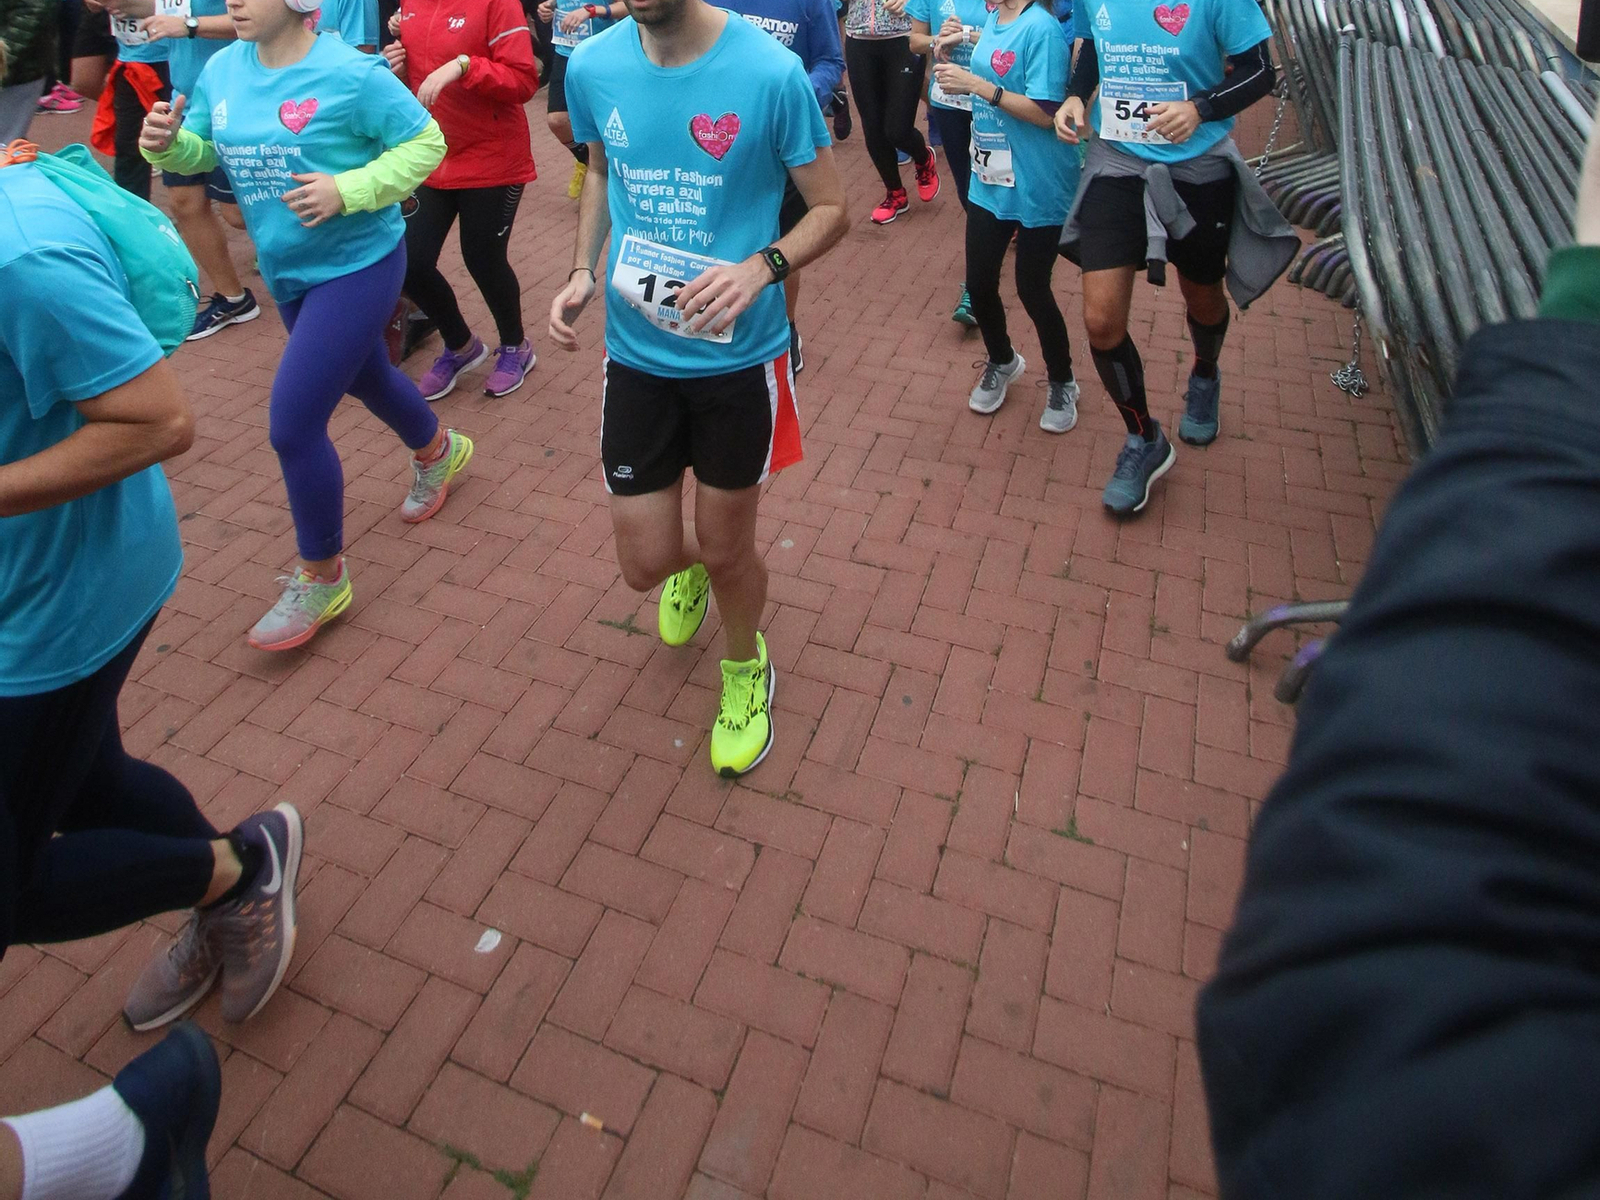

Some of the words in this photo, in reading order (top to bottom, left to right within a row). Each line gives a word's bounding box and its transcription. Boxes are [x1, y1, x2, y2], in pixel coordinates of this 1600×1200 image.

[1104, 42, 1139, 53] Runner
[1141, 44, 1180, 55] Fashion
[1103, 53, 1143, 64] Carrera
[1145, 56, 1165, 66] azul
[1120, 65, 1131, 75] el
[1132, 65, 1170, 75] autismo
[603, 128, 628, 142] ALTEA
[219, 143, 258, 156] Runner
[259, 143, 301, 157] Fashion
[223, 155, 264, 168] Carrera
[266, 156, 288, 168] azul
[621, 162, 671, 181] Runner
[674, 167, 723, 187] Fashion
[623, 179, 676, 198] Carrera
[678, 186, 704, 203] azul
[640, 198, 655, 214] el
[657, 198, 707, 216] autismo
[674, 217, 698, 226] Marzo
[668, 225, 687, 242] te
[689, 227, 716, 247] pare
[635, 245, 660, 259] Runner
[660, 253, 686, 267] Fashion
[627, 256, 642, 265] por
[643, 261, 652, 270] el
[653, 263, 686, 278] autismo
[637, 273, 707, 314] 12
